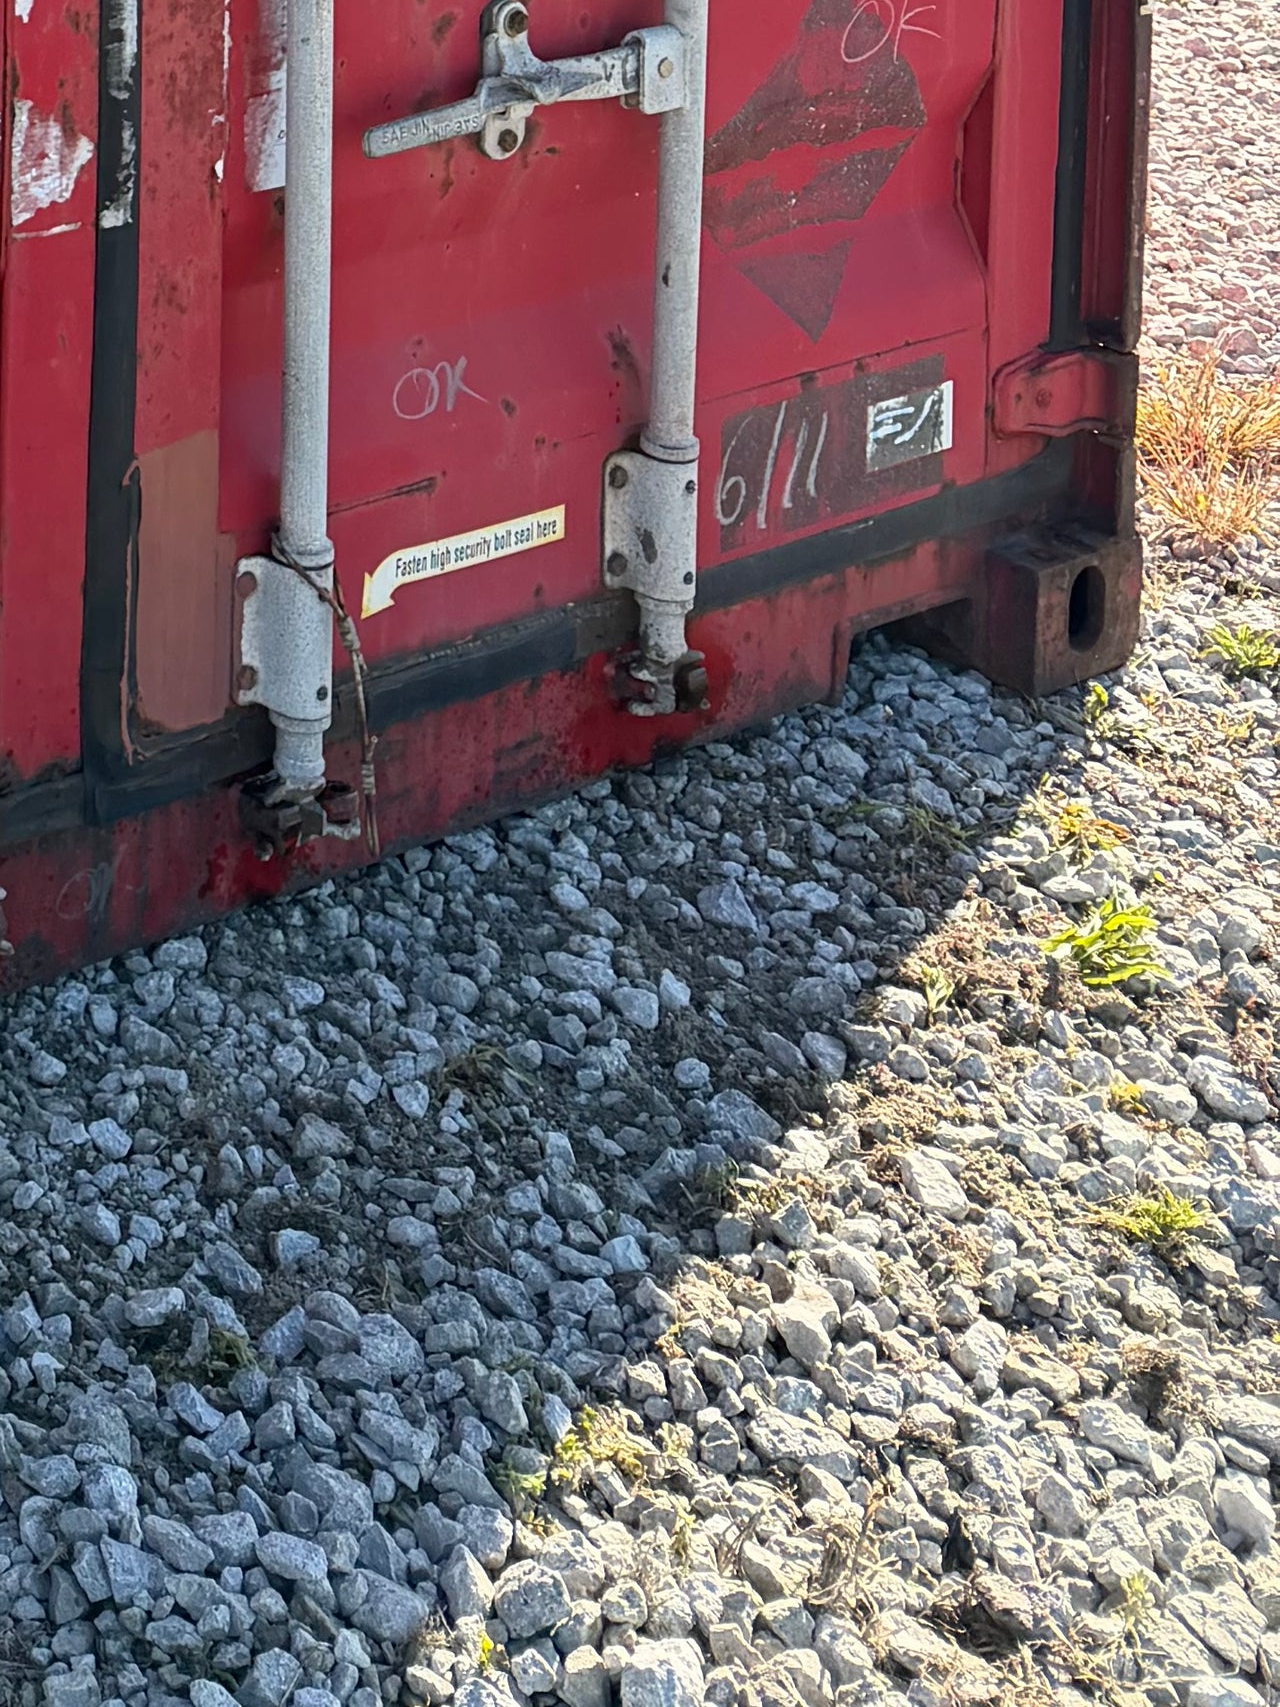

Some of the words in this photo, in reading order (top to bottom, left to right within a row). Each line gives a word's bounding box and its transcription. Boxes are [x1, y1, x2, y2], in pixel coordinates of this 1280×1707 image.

[381, 127, 409, 145] SAE
[395, 556, 428, 578] Fasten
[430, 546, 452, 571] high
[454, 537, 492, 563] security
[494, 529, 512, 552] bolt
[514, 523, 534, 546] seal
[536, 518, 557, 538] here
